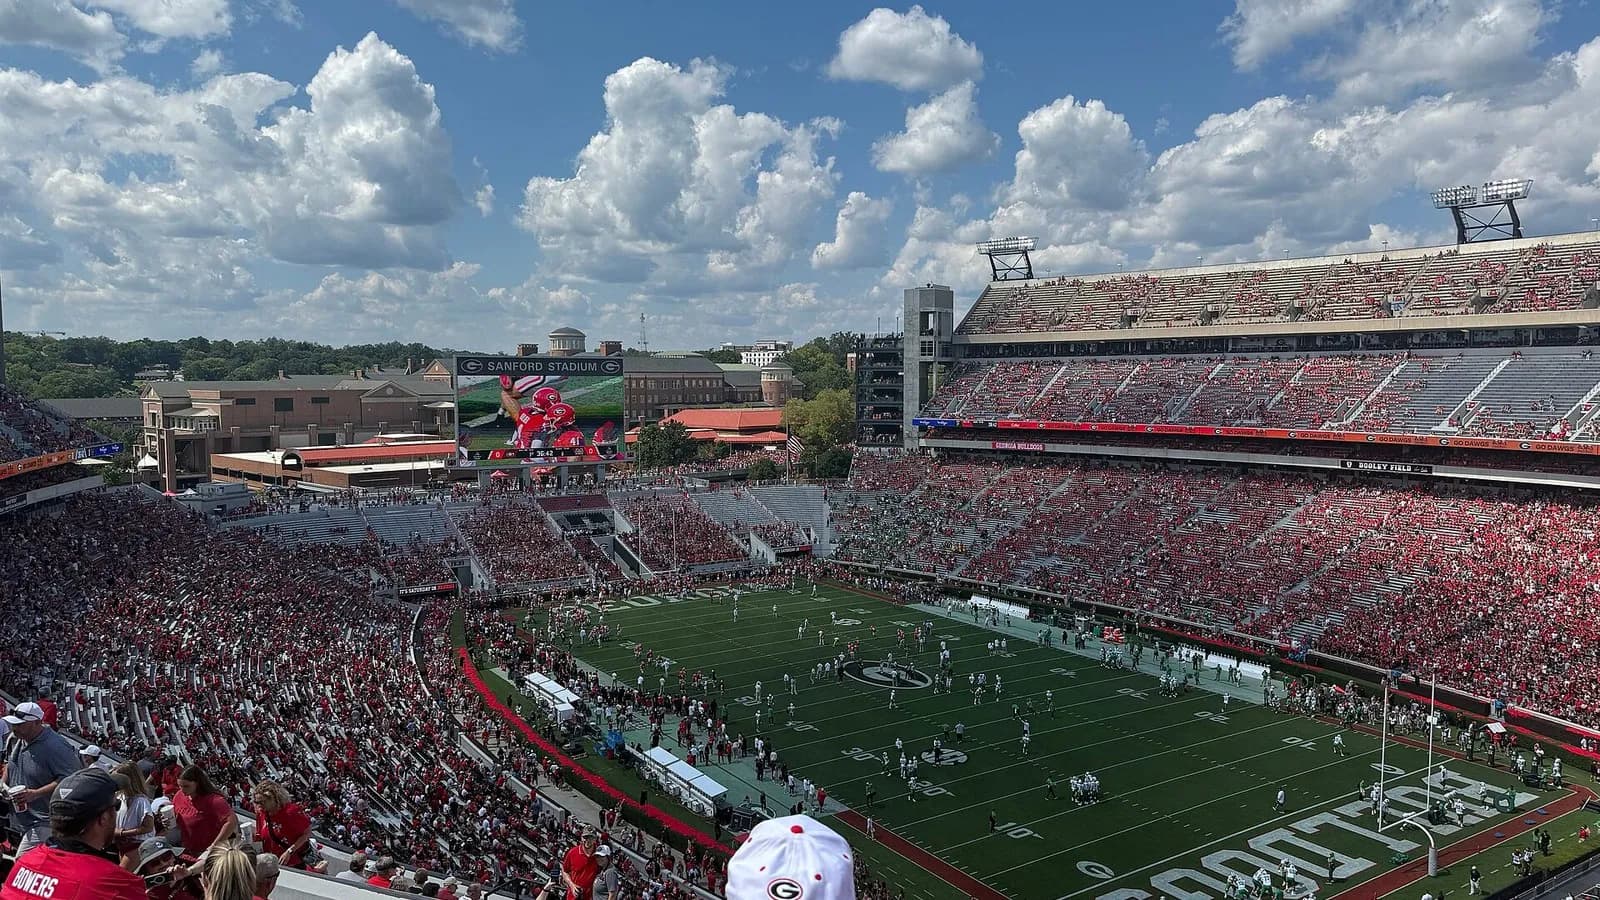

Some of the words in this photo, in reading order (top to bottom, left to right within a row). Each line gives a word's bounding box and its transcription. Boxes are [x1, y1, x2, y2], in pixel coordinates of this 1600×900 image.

[487, 361, 543, 371] SANFORD
[548, 361, 597, 371] STADIUM
[1547, 444, 1575, 452] DAWGS
[1359, 462, 1388, 470] DOOLEY
[915, 780, 946, 796] 20
[995, 822, 1034, 839] 10
[12, 866, 59, 899] BOWERS
